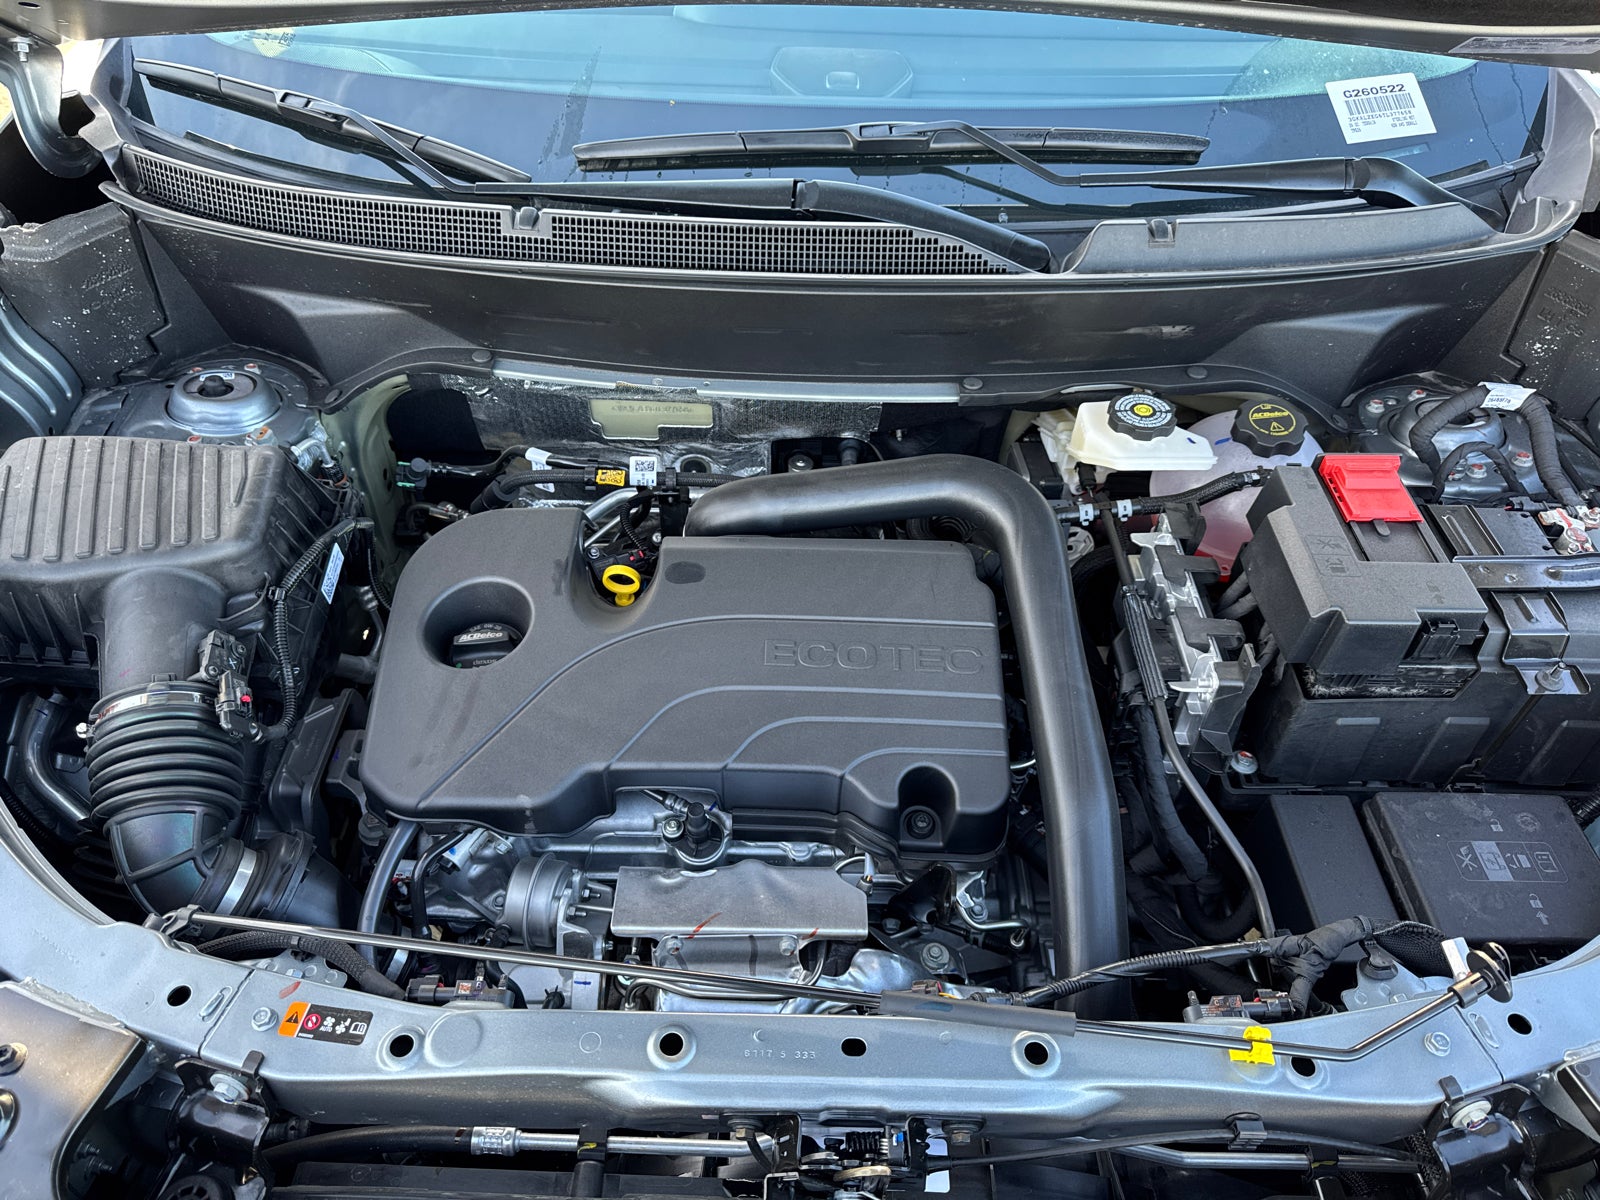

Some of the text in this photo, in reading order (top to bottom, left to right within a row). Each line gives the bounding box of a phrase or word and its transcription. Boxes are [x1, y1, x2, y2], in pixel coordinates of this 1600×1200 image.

[1343, 84, 1406, 98] G260522
[459, 631, 503, 641] ACDelco
[764, 640, 984, 675] ECOTEC
[319, 1025, 333, 1033] AUTO
